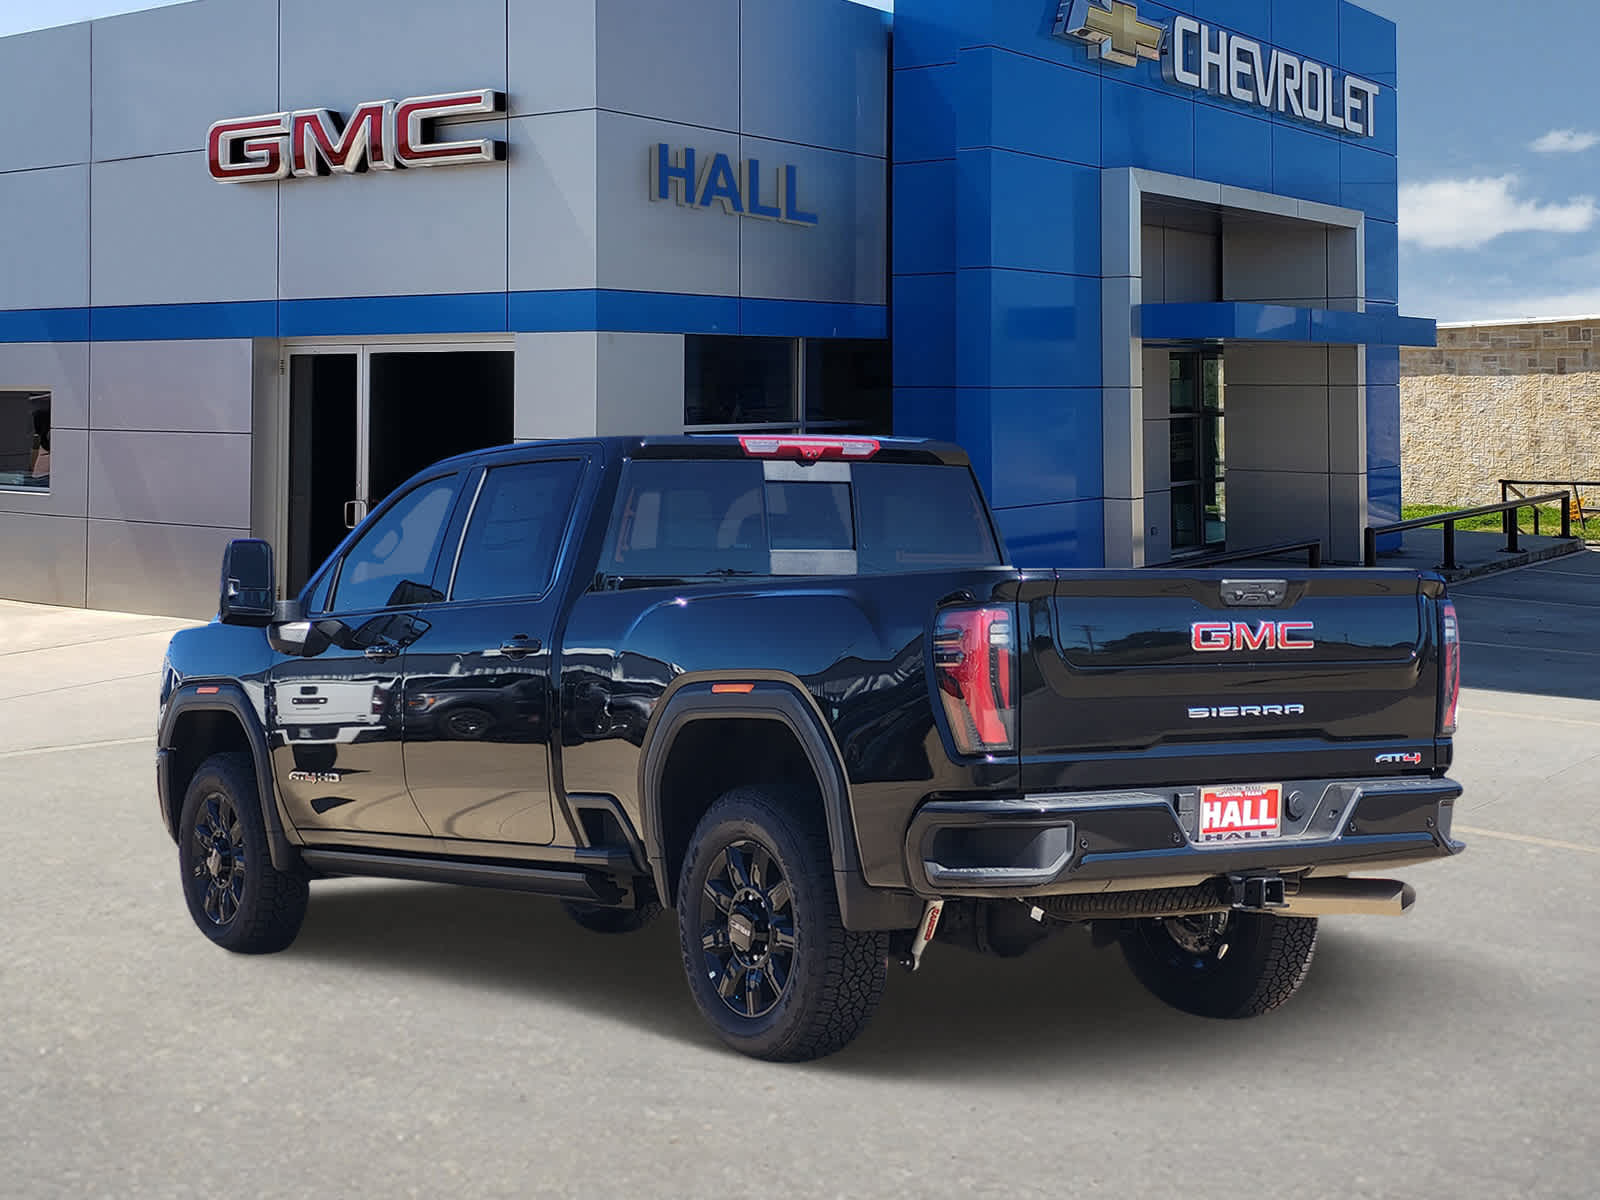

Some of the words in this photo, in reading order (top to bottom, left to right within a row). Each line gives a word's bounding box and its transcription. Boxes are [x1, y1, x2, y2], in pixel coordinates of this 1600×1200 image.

[1172, 15, 1380, 137] CHEVROLET
[205, 88, 505, 183] GMC
[651, 143, 818, 226] HALL
[1191, 620, 1315, 651] GMC
[1188, 703, 1305, 719] SIERRA
[1375, 752, 1422, 765] AT4
[1203, 799, 1277, 829] HALL
